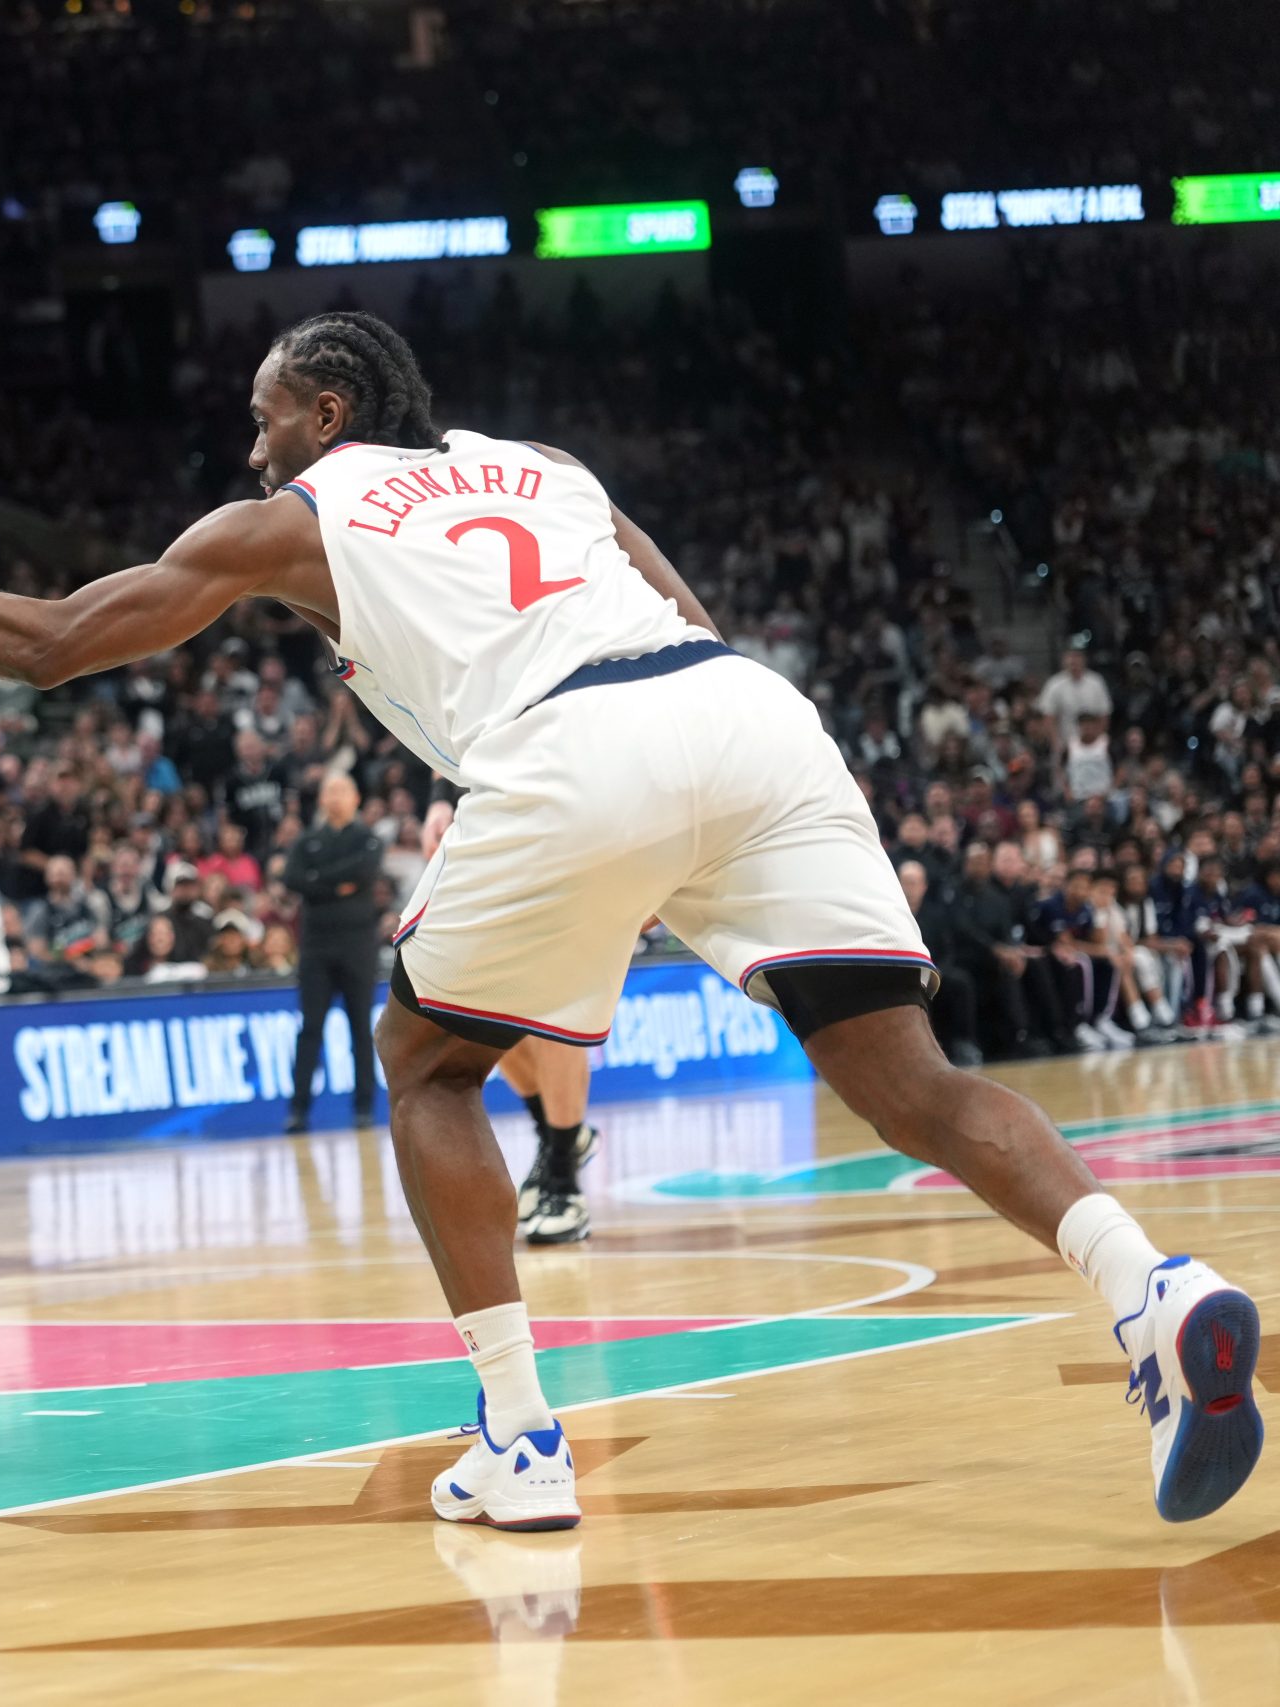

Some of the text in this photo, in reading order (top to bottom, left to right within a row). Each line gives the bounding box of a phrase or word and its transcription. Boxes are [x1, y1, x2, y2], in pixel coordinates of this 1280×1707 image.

[348, 465, 543, 538] LEONARD
[444, 516, 588, 614] 2
[14, 1018, 172, 1122] STREAM
[167, 1012, 255, 1107] LIKE
